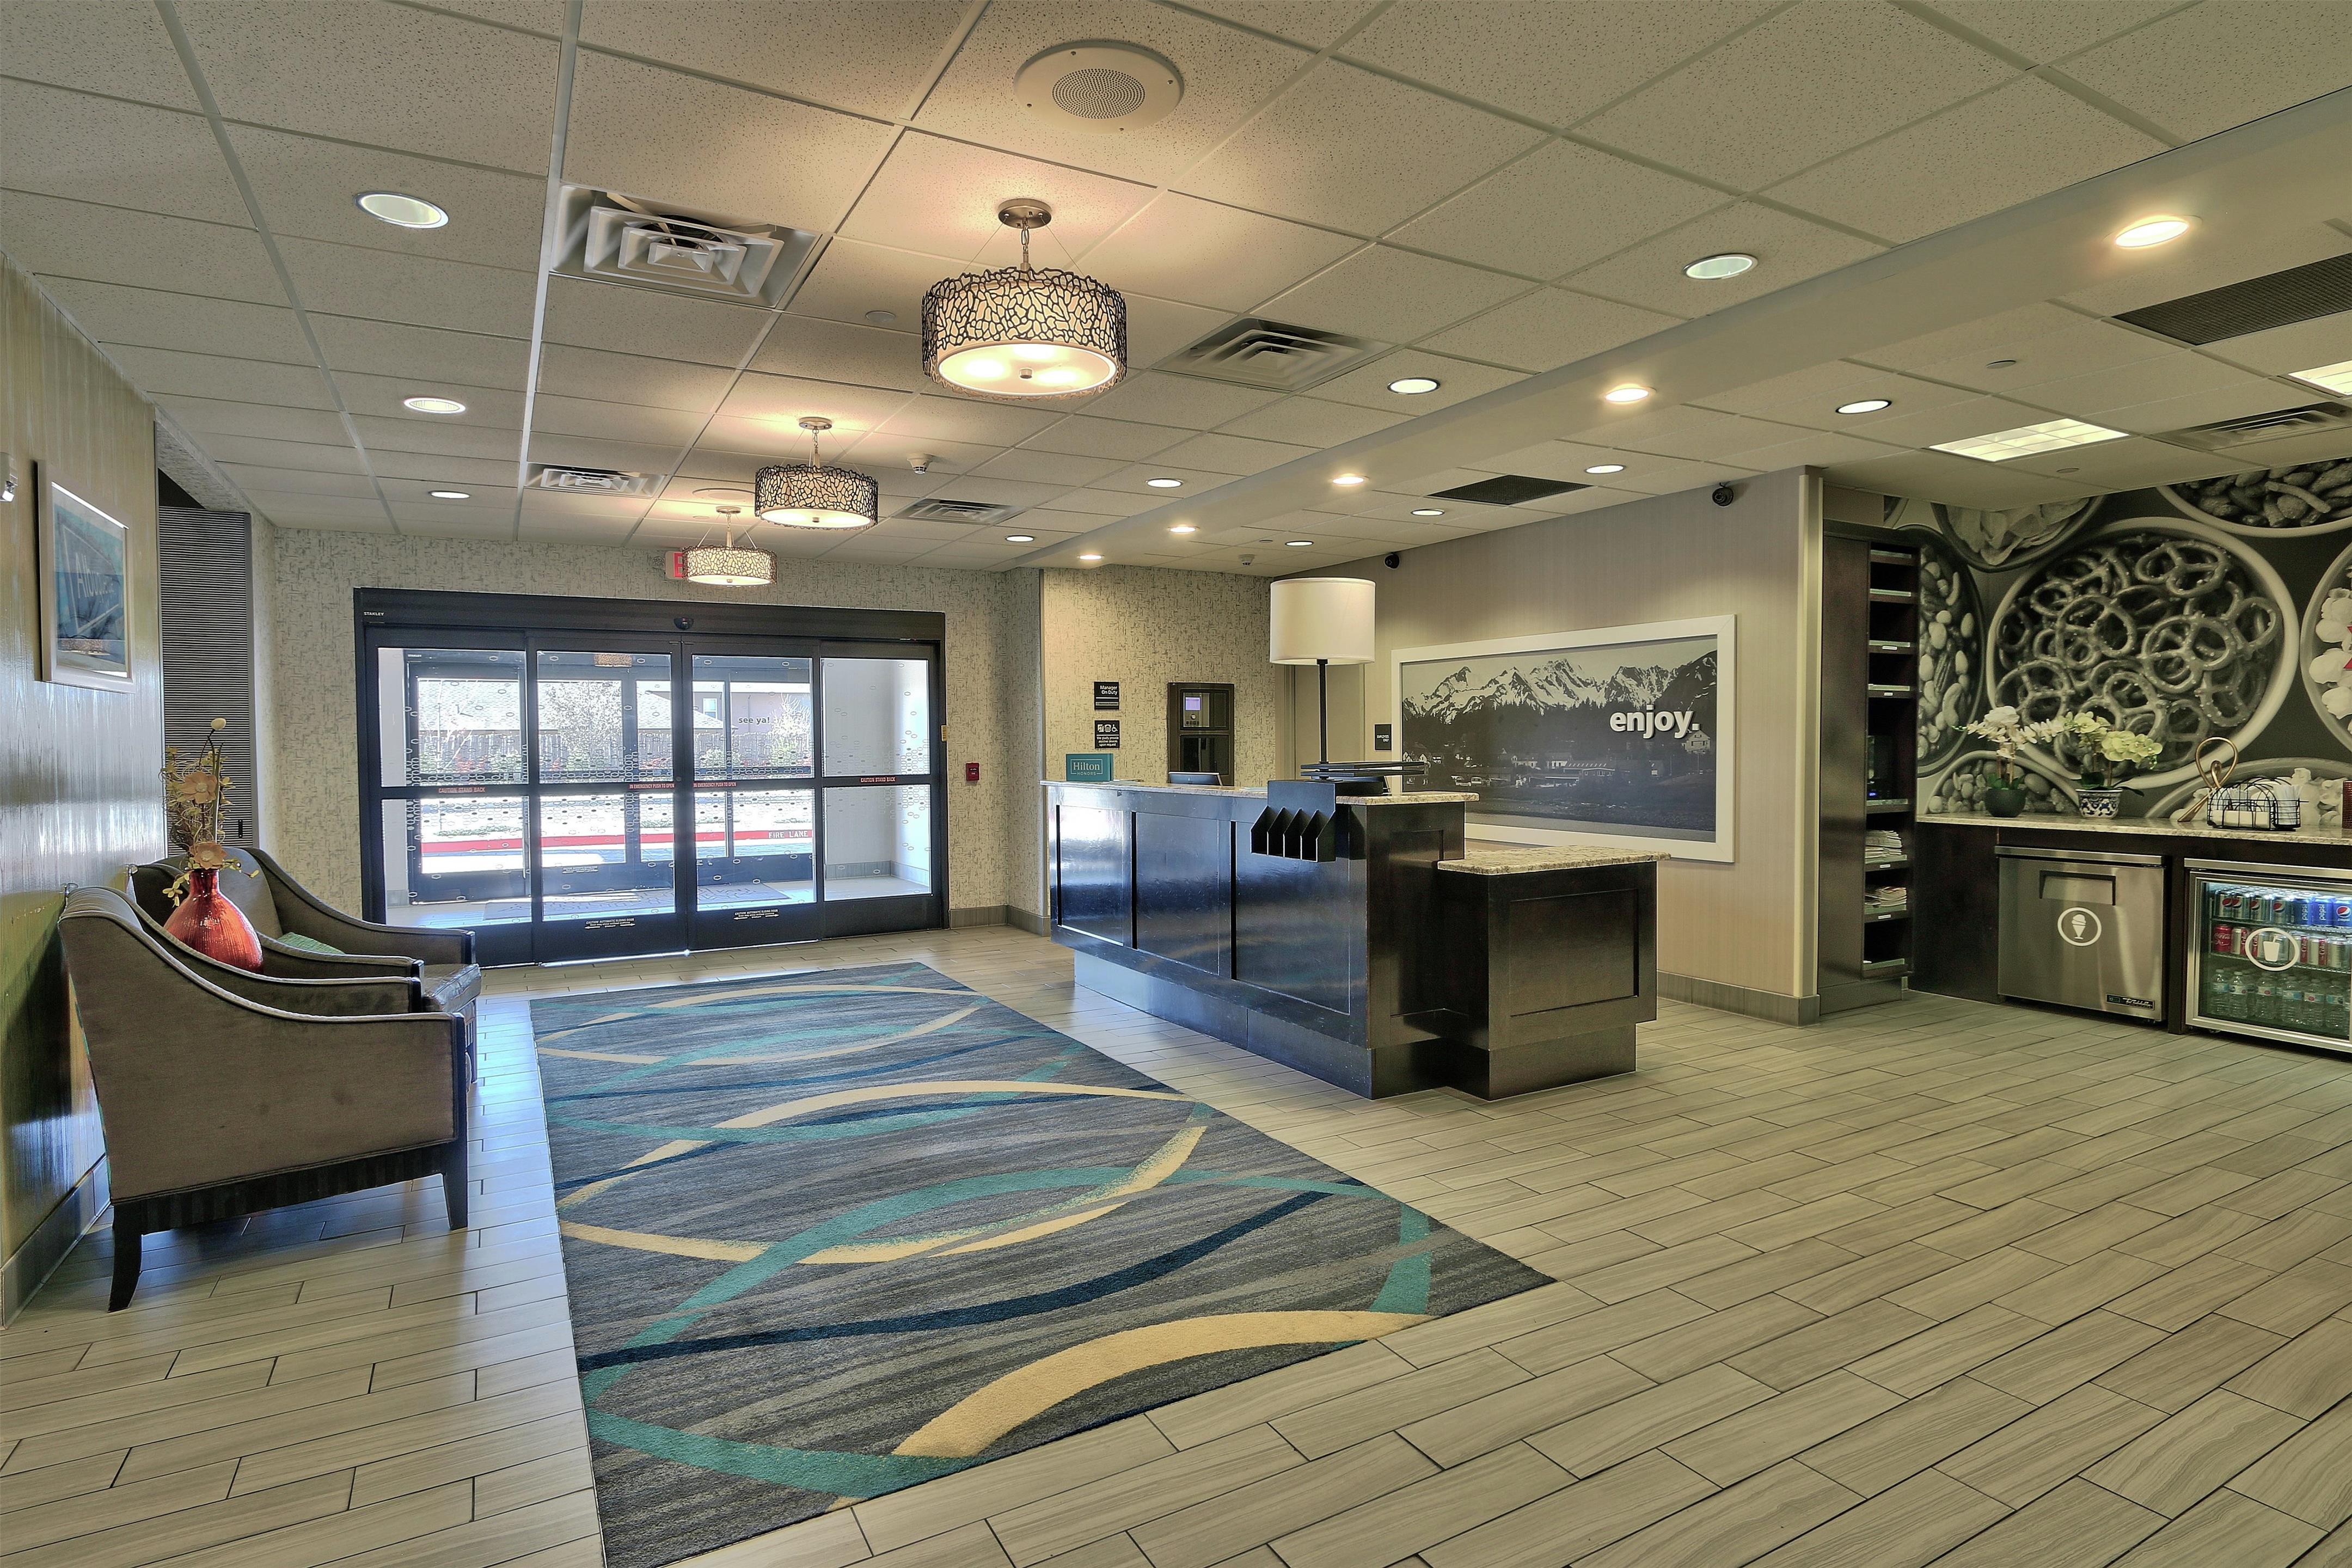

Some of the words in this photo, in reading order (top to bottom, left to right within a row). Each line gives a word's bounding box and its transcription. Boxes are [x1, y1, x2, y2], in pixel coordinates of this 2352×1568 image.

[756, 717, 770, 725] ya!
[1610, 705, 1700, 739] enjoy.
[1073, 762, 1100, 770] Hilton
[2123, 998, 2152, 1006] true
